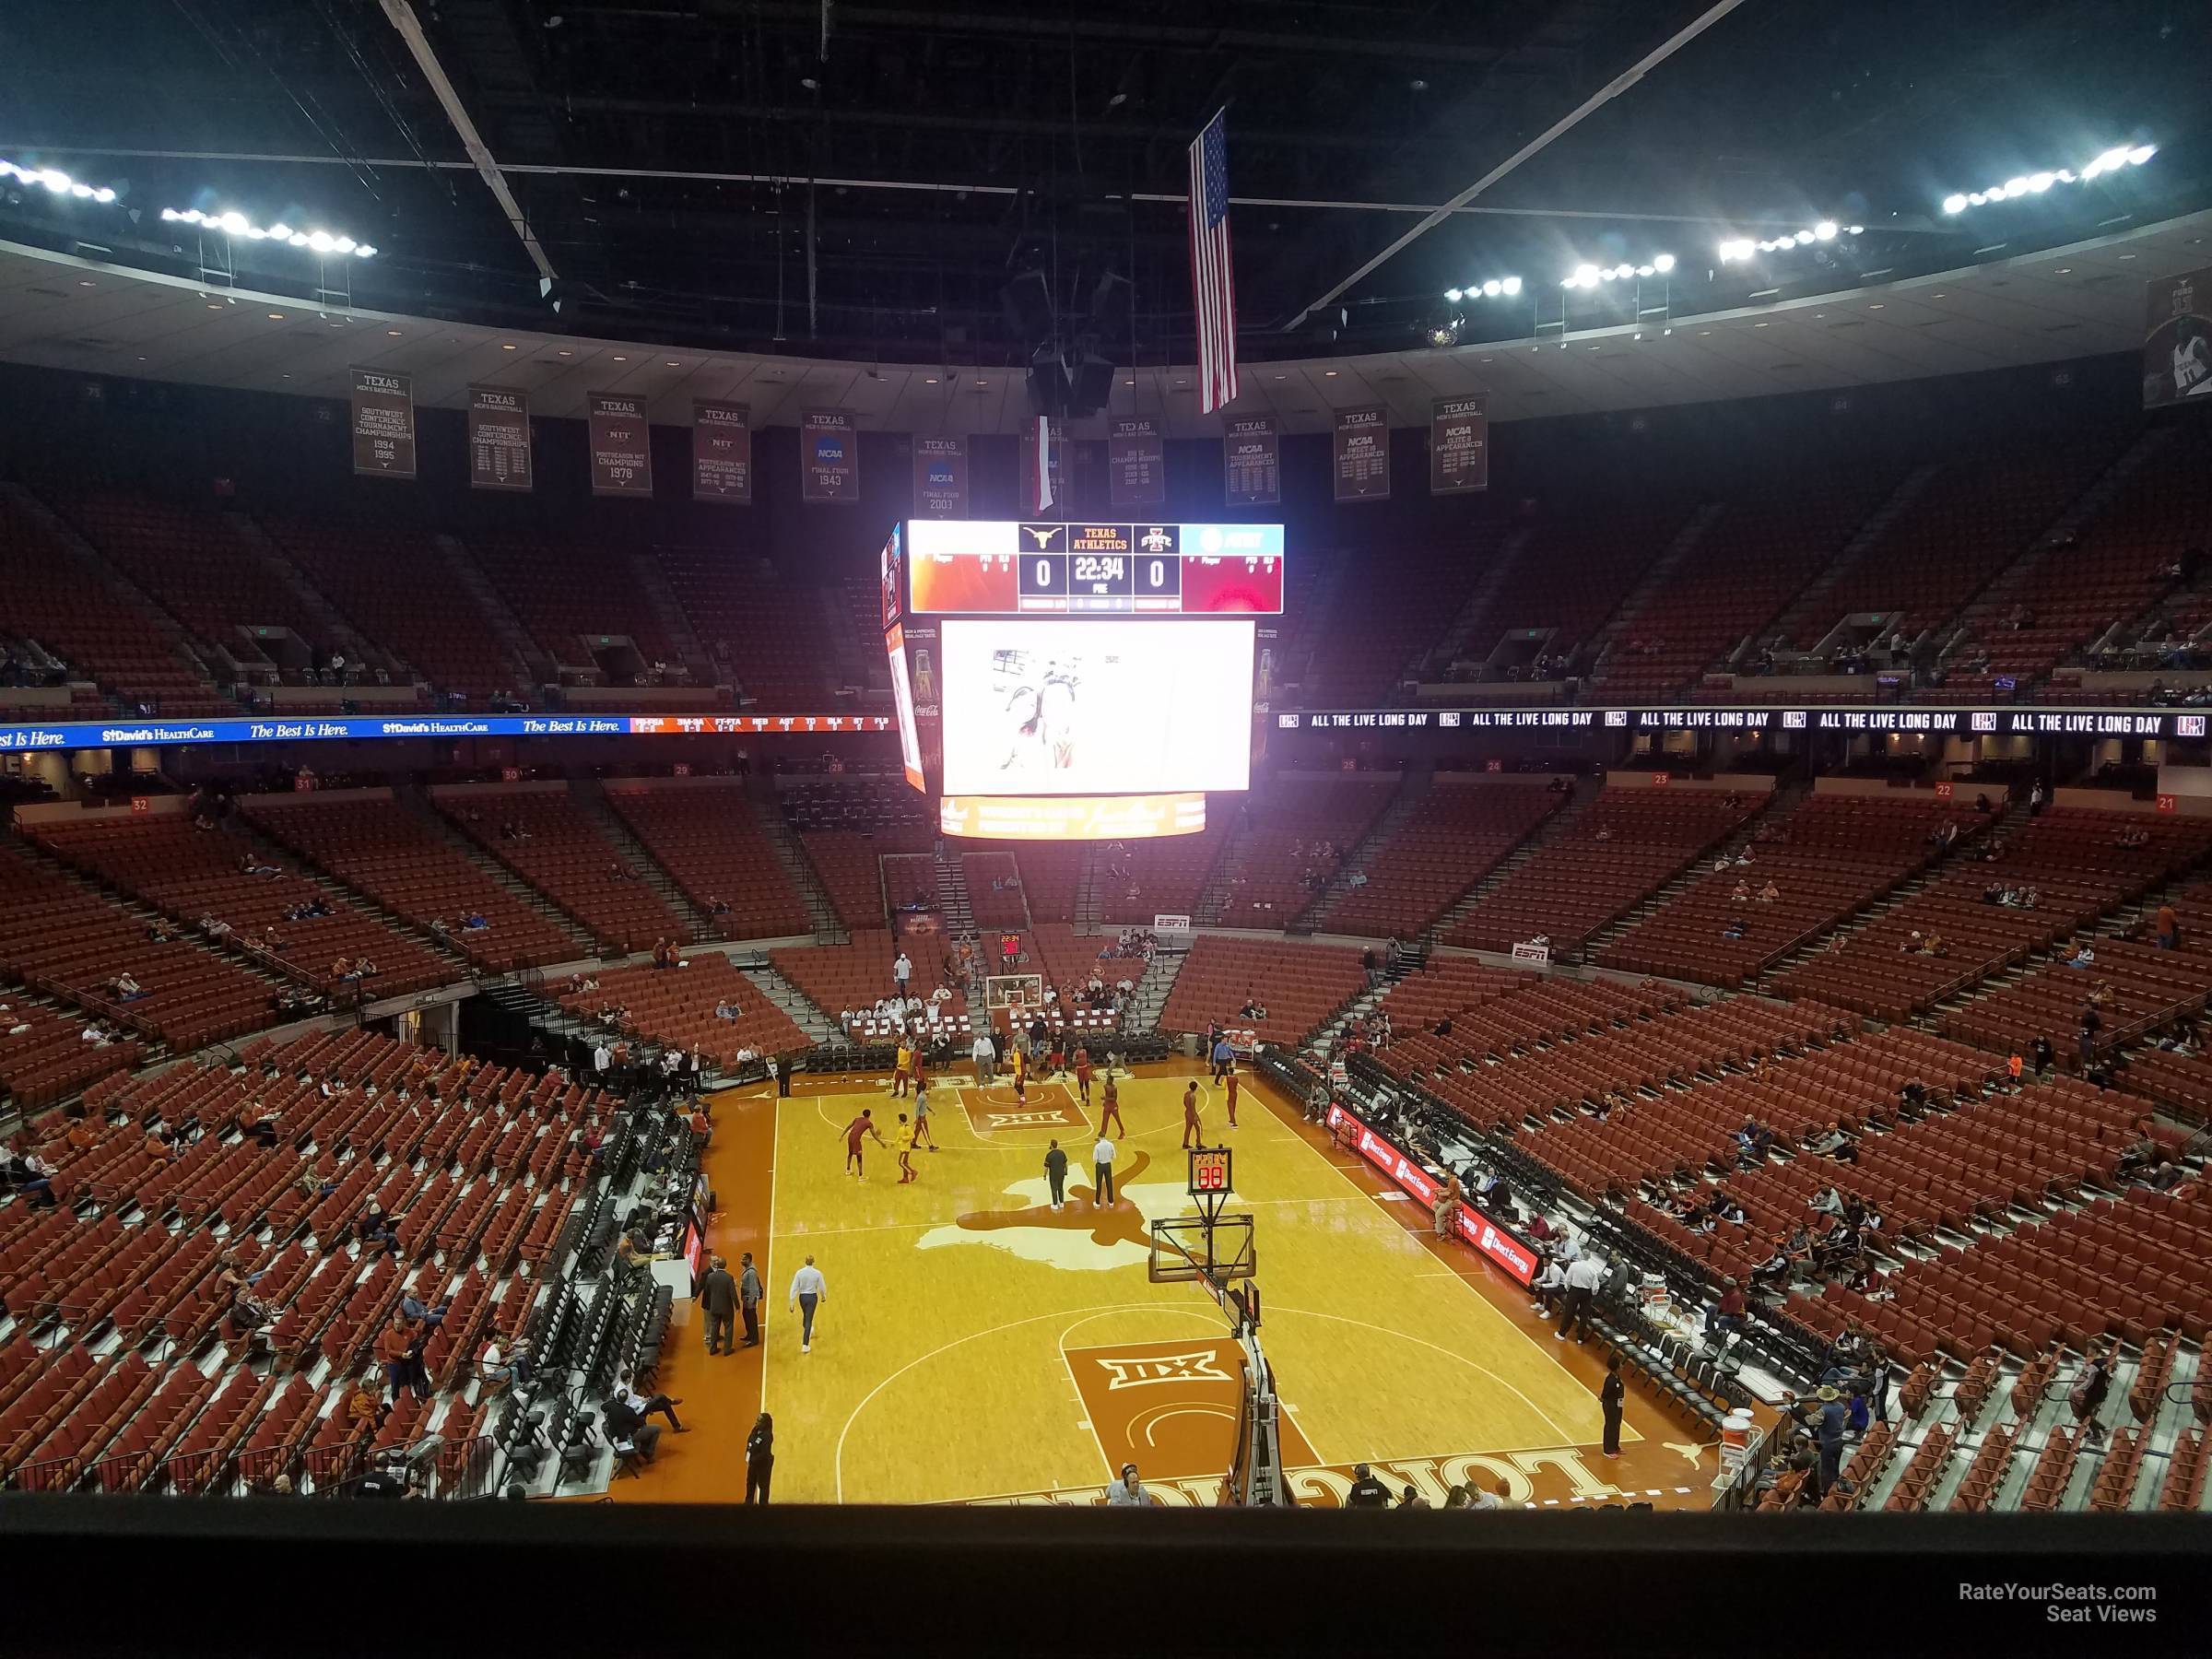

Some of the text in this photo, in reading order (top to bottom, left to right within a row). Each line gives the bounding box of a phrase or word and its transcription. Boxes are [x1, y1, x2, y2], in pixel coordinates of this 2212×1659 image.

[364, 375, 399, 389] TEXAS
[480, 394, 515, 406] TEXAS
[361, 406, 405, 418] SOUTHWEST
[601, 401, 635, 412] TEXAS
[1443, 402, 1475, 414] TEXAS
[360, 414, 406, 424] CONFERENCE
[705, 409, 738, 421] TEXAS
[812, 415, 844, 425] TEXAS
[1346, 413, 1376, 424] TEXAS
[359, 420, 407, 431] TOURNAMENT
[479, 424, 520, 434] SOUTHWEST
[1235, 421, 1265, 431] TEXAS
[355, 427, 412, 440] CHAMPIONSHIPS
[477, 430, 523, 441] CONFERENCE
[1446, 426, 1471, 437] NCAA
[374, 440, 394, 450] 1994
[473, 437, 527, 448] CHAMPIONSHIPS
[712, 439, 734, 447] NIT
[924, 441, 956, 451] TEXAS
[1347, 436, 1373, 446] NCAA
[1436, 441, 1482, 452] APPEARANCES
[818, 449, 842, 458] NCAA
[1239, 444, 1263, 453] NCAA
[375, 450, 394, 460] 1995
[1339, 451, 1384, 461] APPEARANCES
[598, 458, 644, 467] CHAMPIONS
[610, 467, 633, 479] 1978
[929, 474, 954, 483] NCAA
[819, 476, 841, 486] 1943
[1085, 528, 1116, 538] TEXAS
[1074, 539, 1127, 550] ATHLETICS
[1037, 559, 1051, 586] 0
[1076, 557, 1124, 581] 22:34
[1150, 560, 1163, 587] 0
[779, 718, 794, 726] AST
[1312, 713, 1428, 726] ALL THE LIVE LONG DAY
[1473, 712, 1593, 725] ALL THE LIVE LONG DAY
[1641, 712, 1769, 726] ALL THE LIVE LONG DAY
[1820, 713, 1957, 728] ALL THE LIVE LONG DAY
[2012, 714, 2161, 734] ALL THE LIVE LONG DAY
[250, 724, 347, 737] The Best Is Here.
[523, 720, 619, 733] The Best Is Here.
[15, 731, 65, 747] Is Here.
[677, 766, 688, 774] 29
[1488, 762, 1500, 771] 24
[505, 771, 517, 780] 30
[1655, 775, 1667, 783] 23
[297, 780, 310, 789] 31
[1937, 785, 1951, 795] 22
[135, 800, 147, 810] 32
[2159, 797, 2173, 809] 21
[1158, 919, 1187, 927] ESPN
[1515, 947, 1546, 959] ESPN
[1493, 1238, 1528, 1274] Direct Energy
